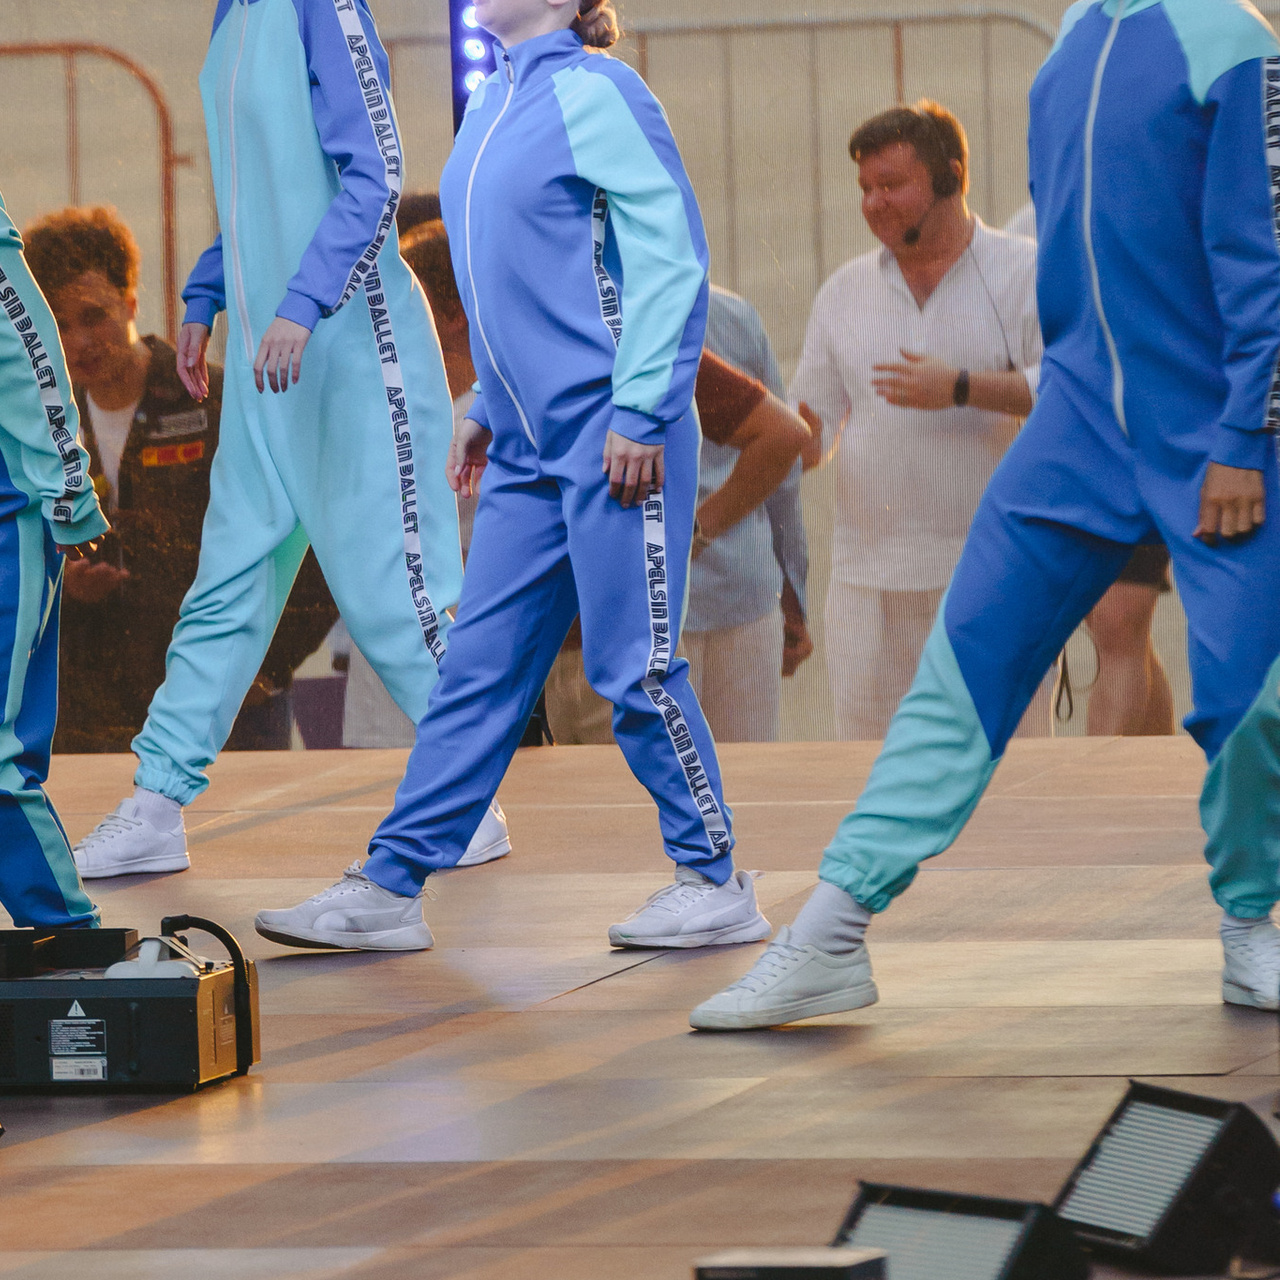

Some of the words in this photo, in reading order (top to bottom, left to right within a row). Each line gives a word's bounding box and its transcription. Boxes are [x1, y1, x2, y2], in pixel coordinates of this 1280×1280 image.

[346, 34, 384, 109] APELSIN
[370, 108, 400, 178] BALLET
[14, 316, 57, 389] BALLET
[367, 293, 398, 364] BALLET
[386, 386, 413, 463] APELSIN
[399, 463, 419, 534] BALLET
[405, 552, 437, 627] APELSIN
[646, 542, 667, 619] APELSIN
[648, 688, 694, 753] APELSIN
[681, 751, 719, 816] BALLET
